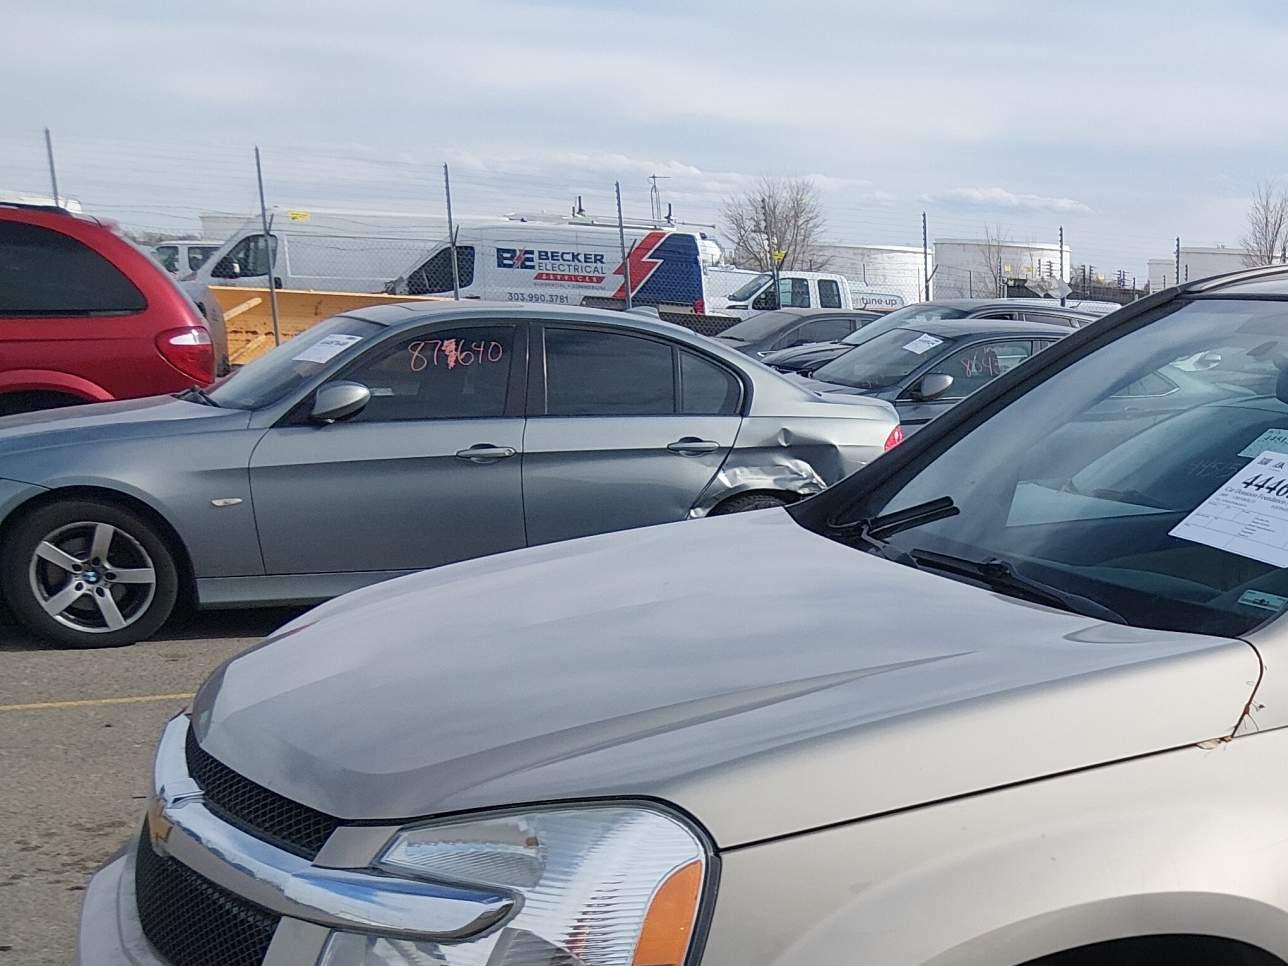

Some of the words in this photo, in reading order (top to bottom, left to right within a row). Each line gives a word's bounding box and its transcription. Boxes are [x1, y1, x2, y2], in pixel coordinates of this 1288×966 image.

[537, 250, 606, 264] BECKER
[537, 262, 607, 274] ELECTRICAL
[507, 292, 569, 303] 303.990.3781
